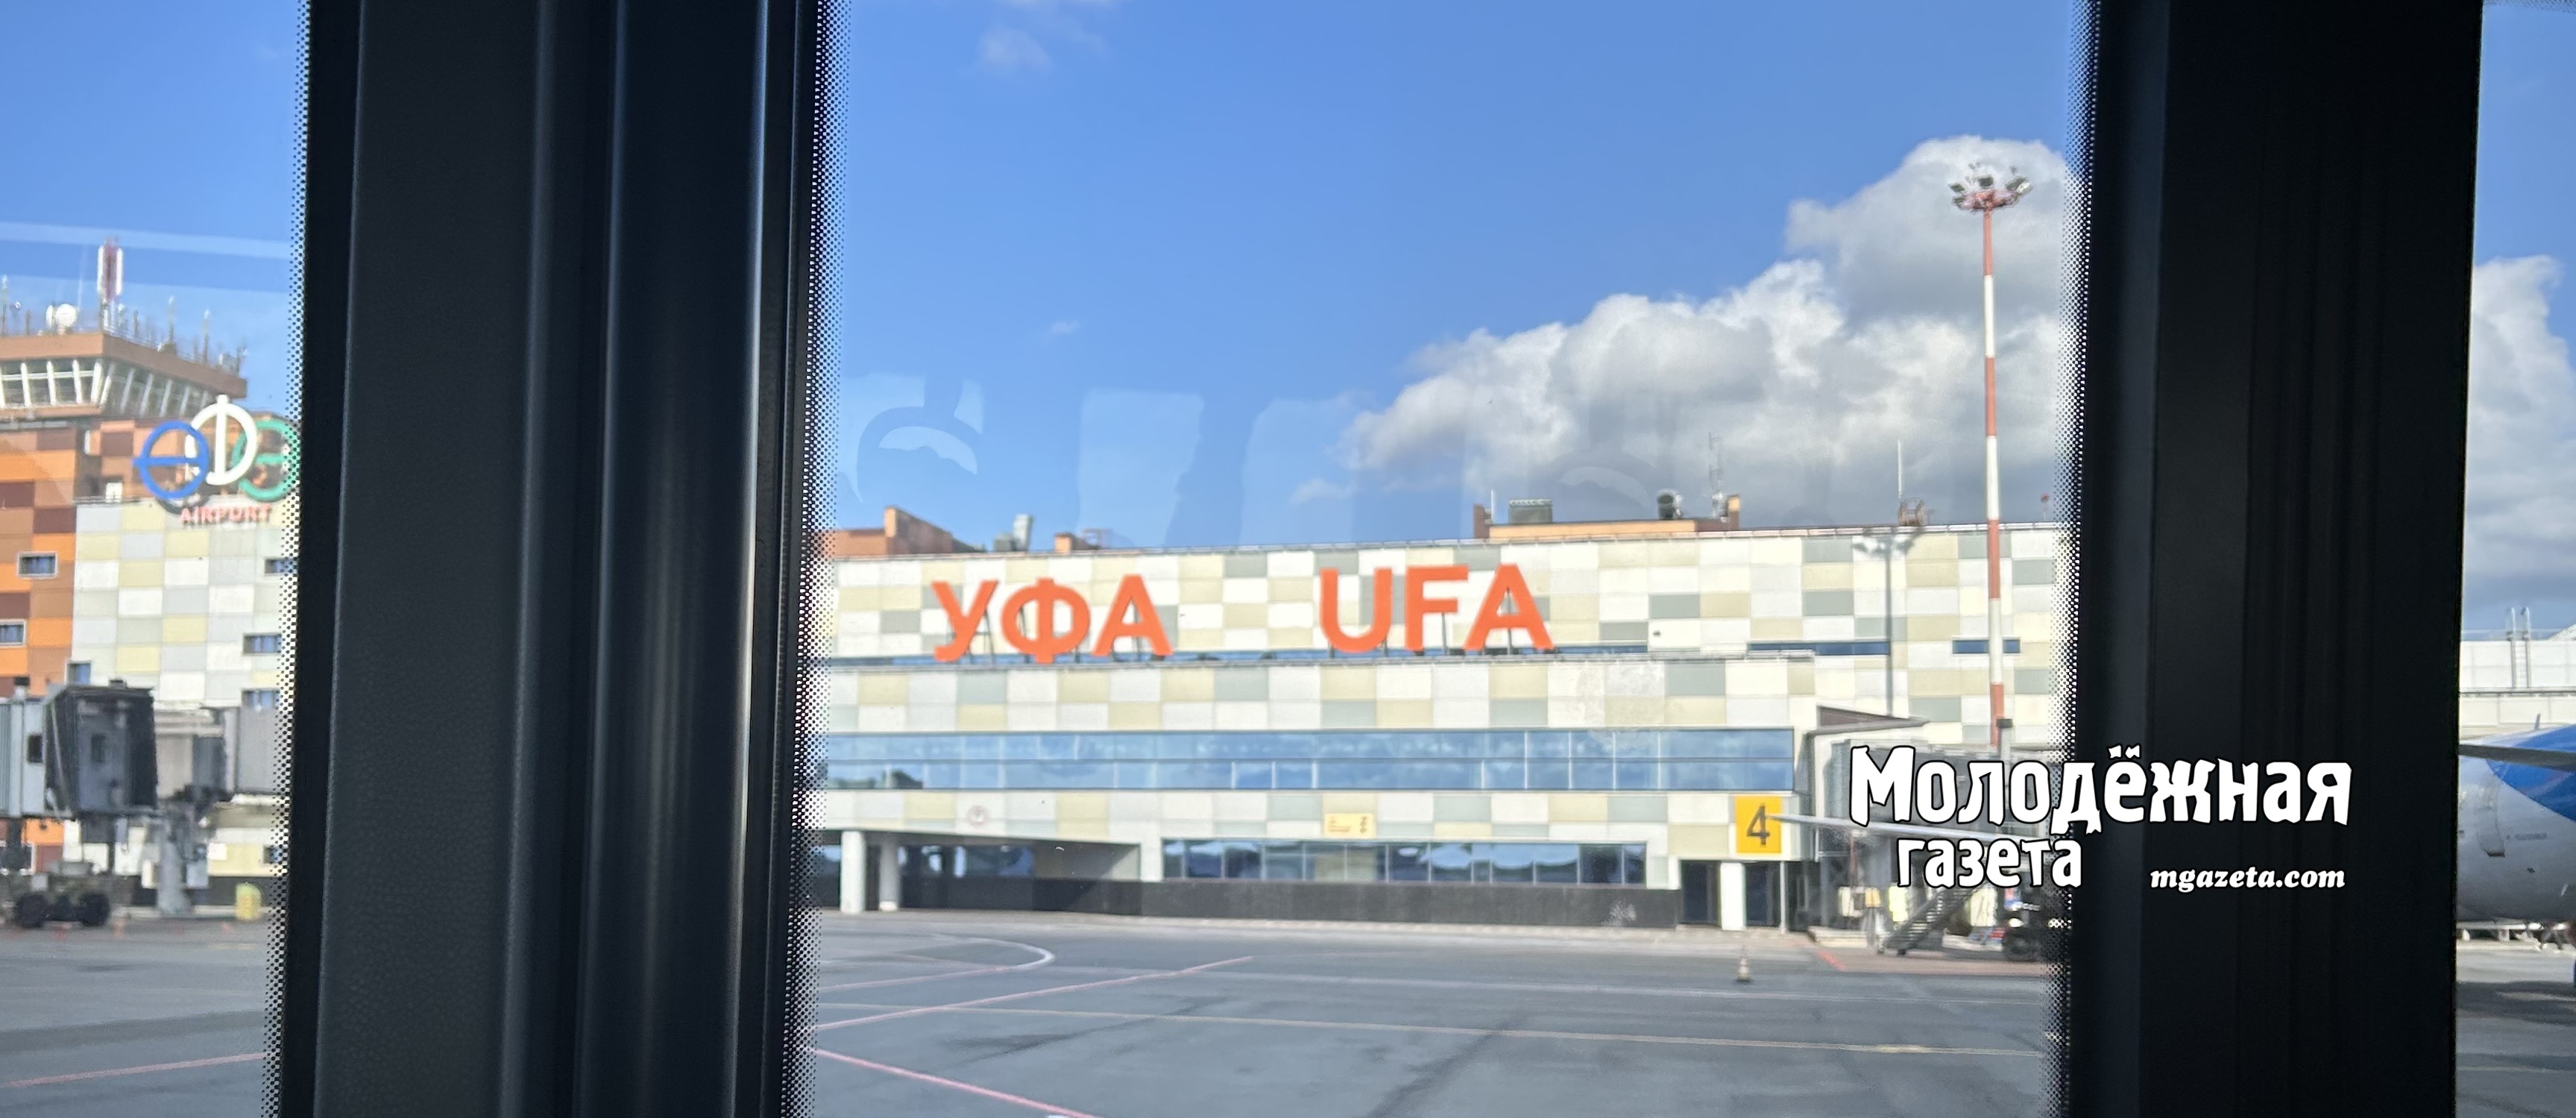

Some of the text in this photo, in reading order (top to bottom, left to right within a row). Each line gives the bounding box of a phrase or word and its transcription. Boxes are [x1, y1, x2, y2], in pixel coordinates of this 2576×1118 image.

[179, 503, 272, 525] AIRPORT
[930, 574, 1174, 665] УФА
[1319, 563, 1555, 654] UFA
[1746, 803, 1771, 847] 4
